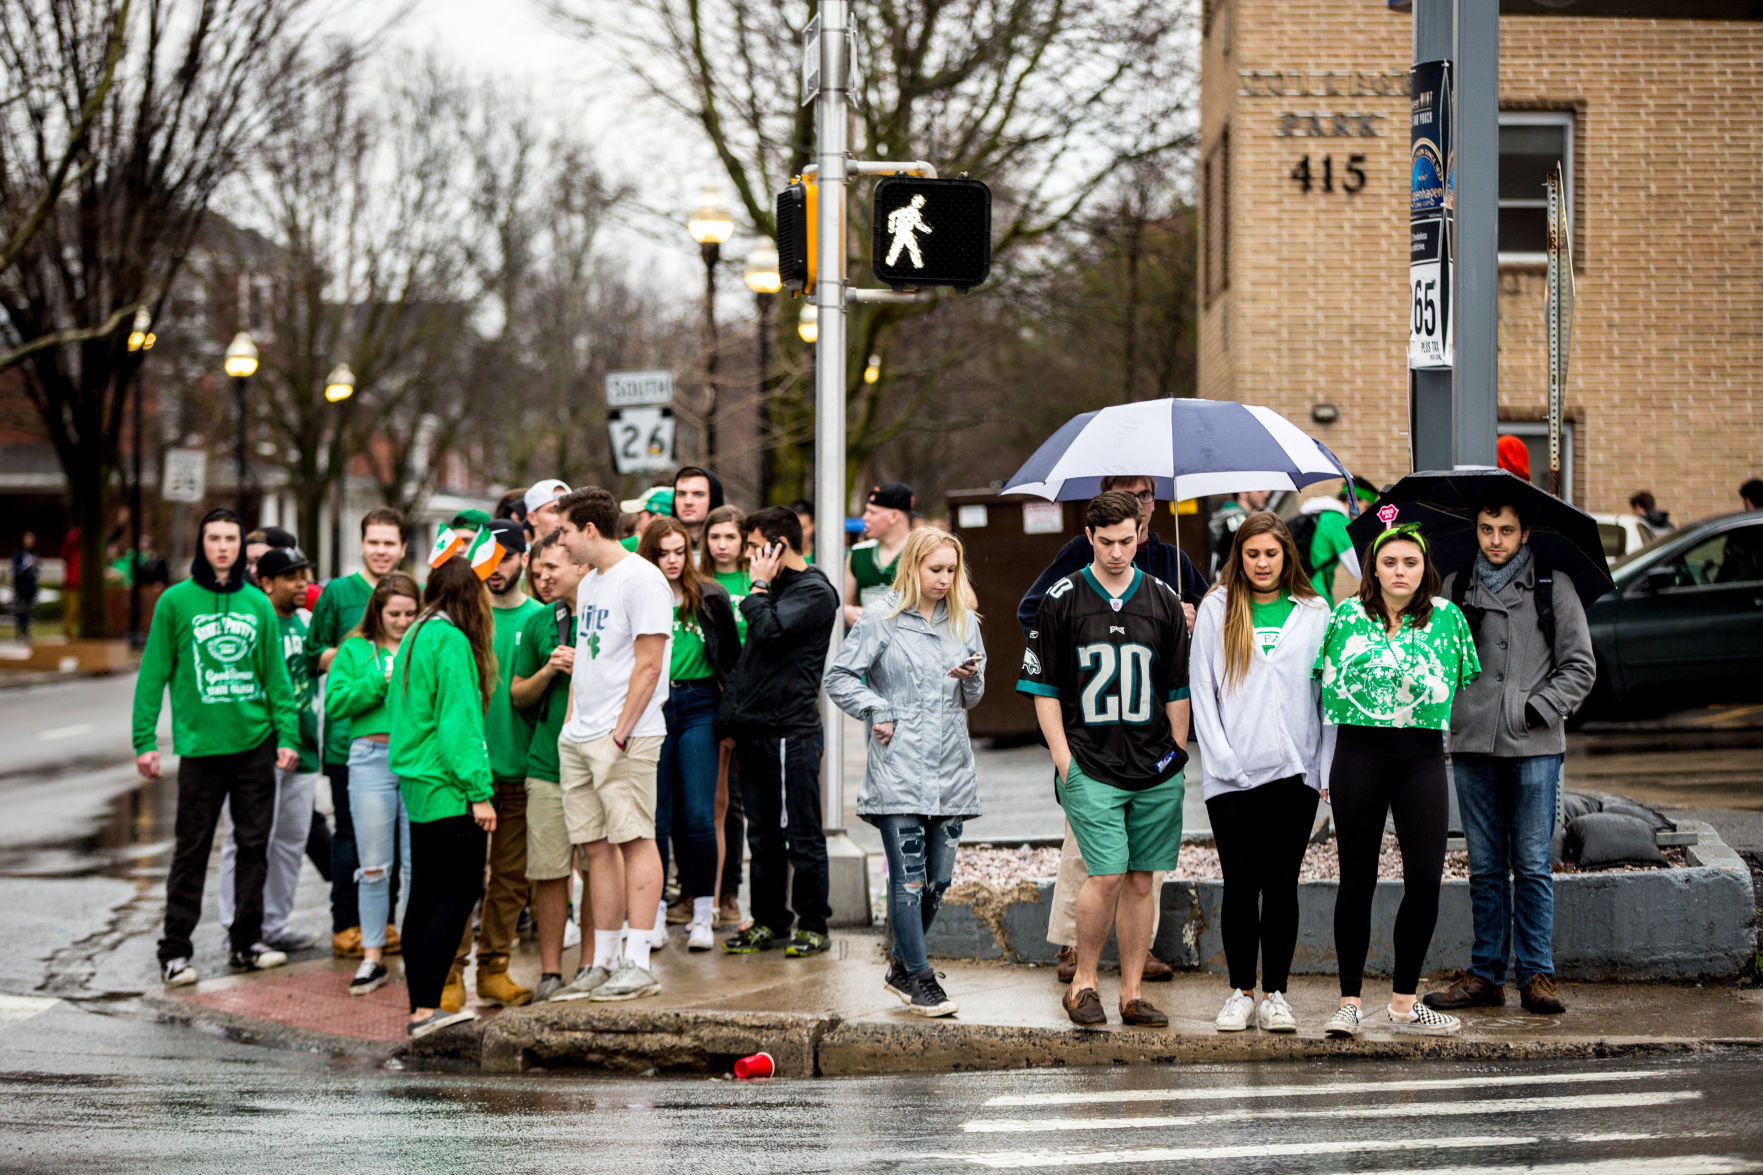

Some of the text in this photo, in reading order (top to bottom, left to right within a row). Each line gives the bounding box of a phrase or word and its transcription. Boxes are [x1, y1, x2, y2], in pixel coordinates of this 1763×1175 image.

[1282, 112, 1377, 137] PARK
[1291, 154, 1367, 193] 415
[1410, 280, 1436, 337] 65
[621, 424, 666, 459] 26
[1075, 641, 1156, 727] 20
